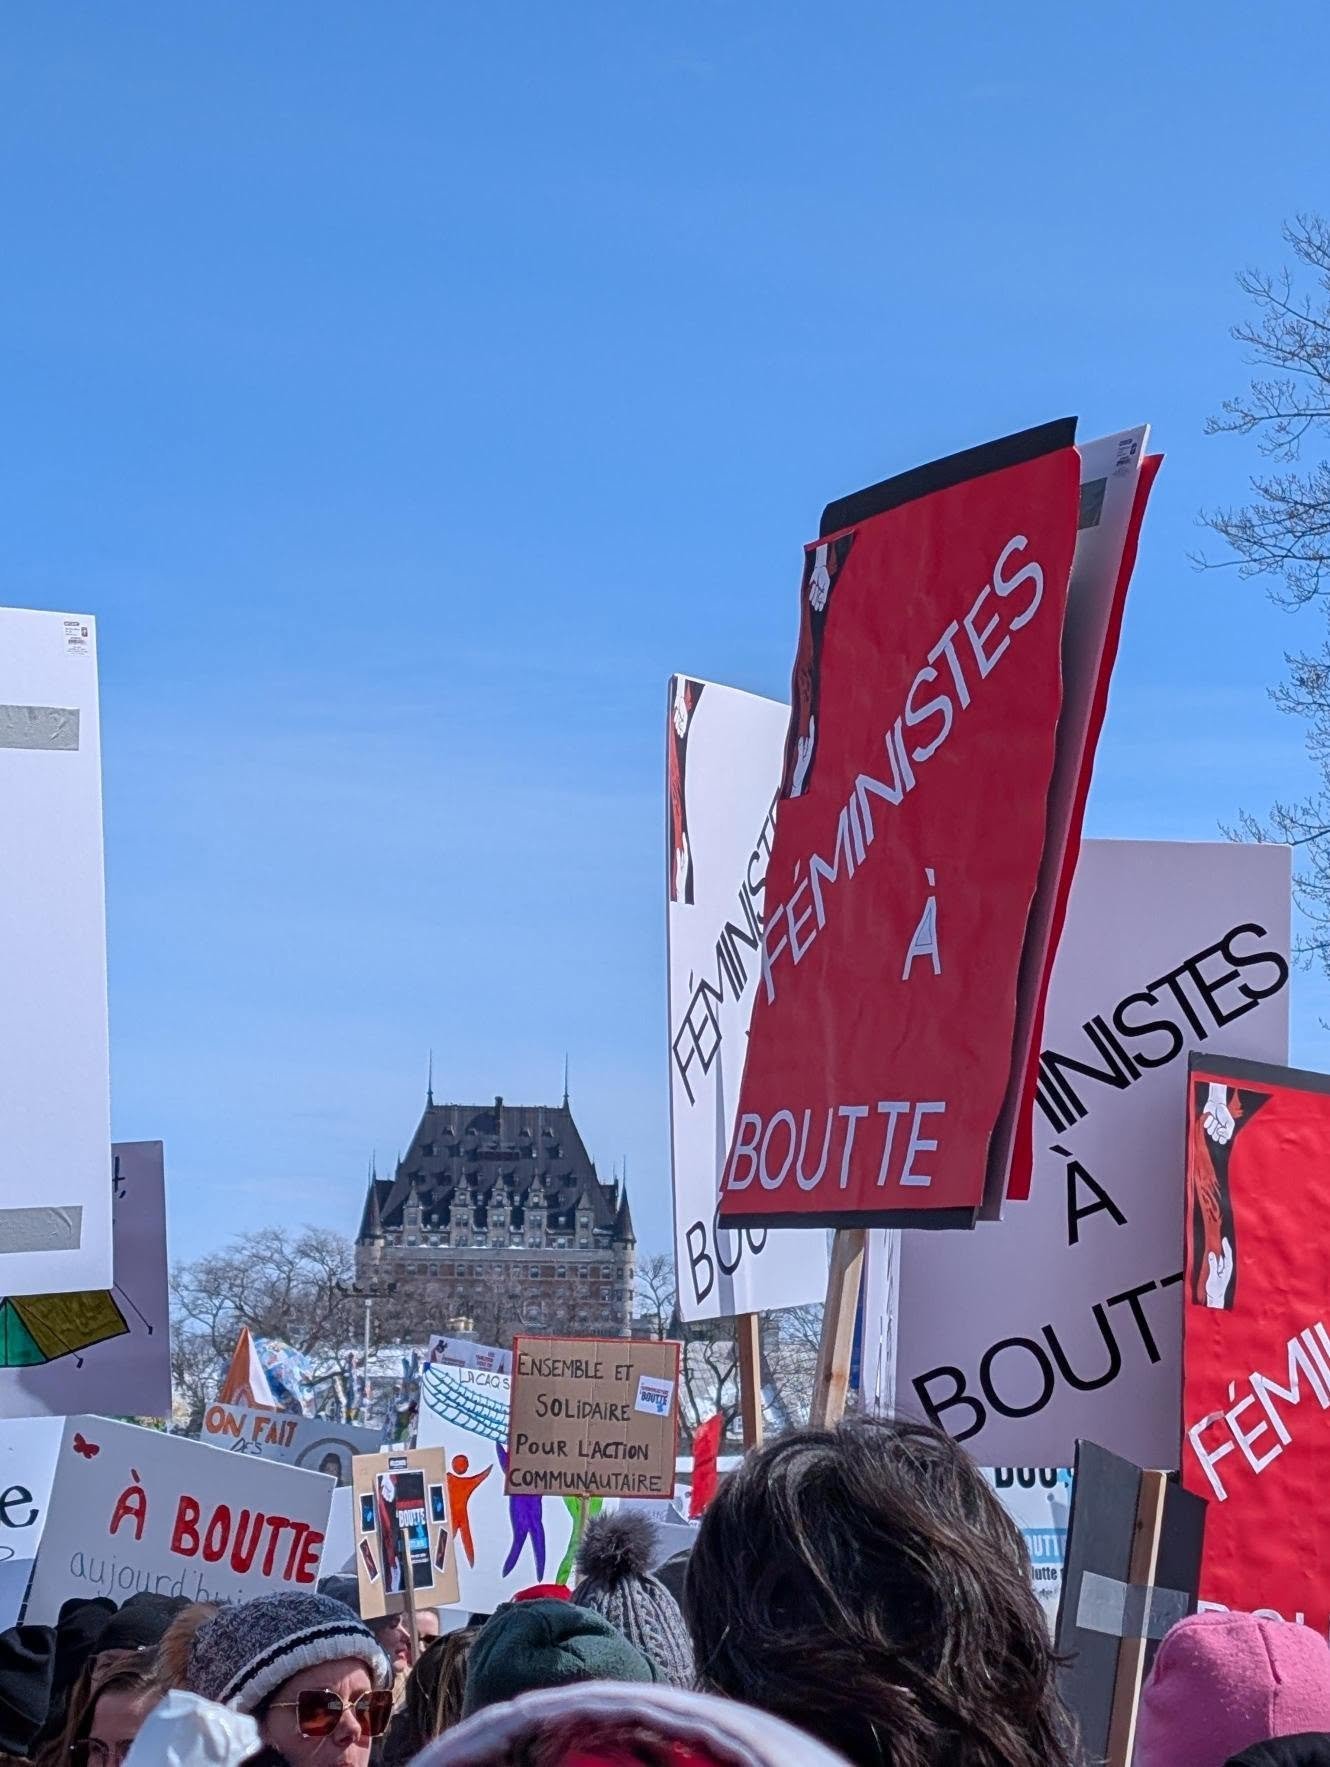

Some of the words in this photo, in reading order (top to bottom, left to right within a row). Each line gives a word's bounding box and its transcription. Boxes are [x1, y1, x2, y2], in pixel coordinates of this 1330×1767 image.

[761, 534, 1045, 1006] FÉMINISTES
[901, 867, 942, 981] À
[727, 1101, 946, 1191] BOUTTE
[1048, 1144, 1129, 1247] À
[517, 1352, 604, 1379] ENSEMBLE
[614, 1364, 635, 1382] ET
[1188, 1321, 1330, 1502] FÉMI
[204, 1405, 247, 1438] ON
[251, 1416, 299, 1448] FAIT
[109, 1468, 148, 1541] À
[169, 1495, 325, 1584] BOUTTE
